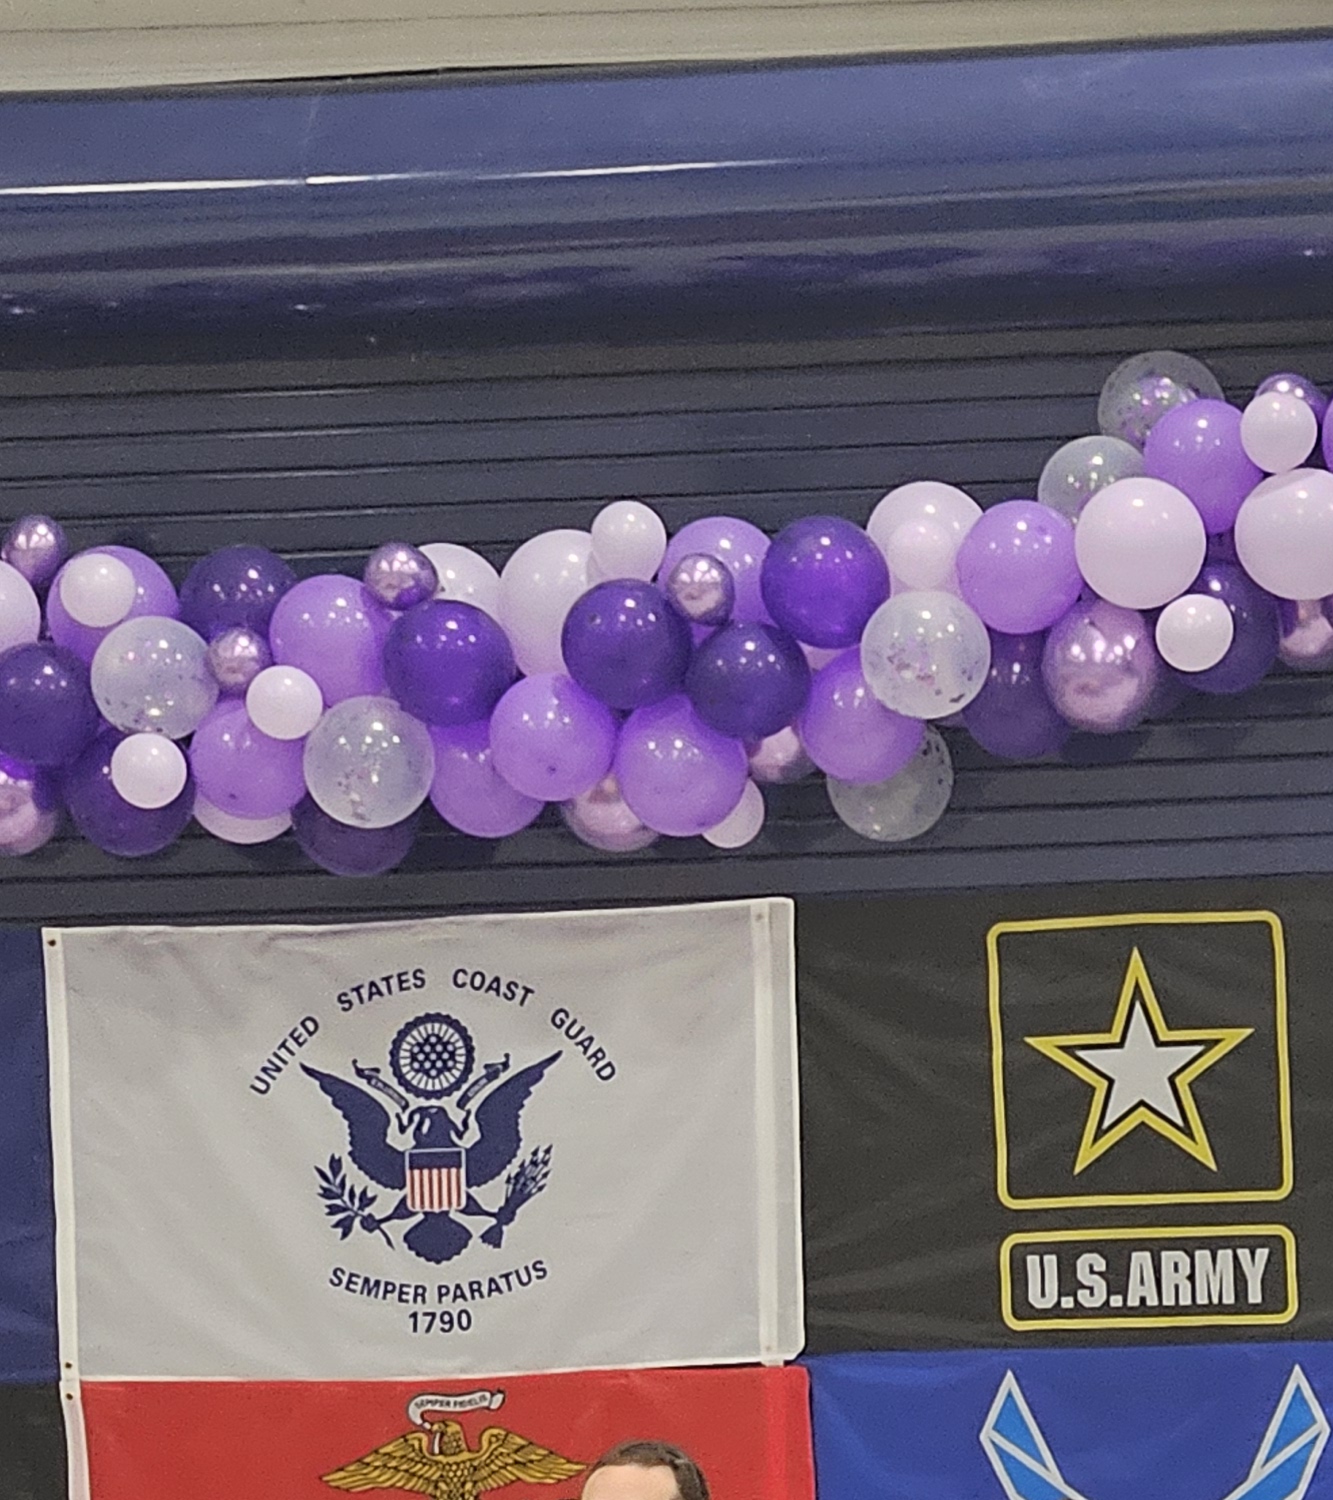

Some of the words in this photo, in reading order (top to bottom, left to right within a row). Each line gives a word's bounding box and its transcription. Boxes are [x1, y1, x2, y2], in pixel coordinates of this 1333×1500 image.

[249, 1015, 320, 1096] UNITED
[336, 968, 426, 1012] STATES
[452, 968, 535, 1007] COAST
[550, 1007, 616, 1082] GUARD
[328, 1266, 428, 1305] SEMPER
[437, 1259, 548, 1304] PARATUS
[408, 1308, 473, 1334] 1790
